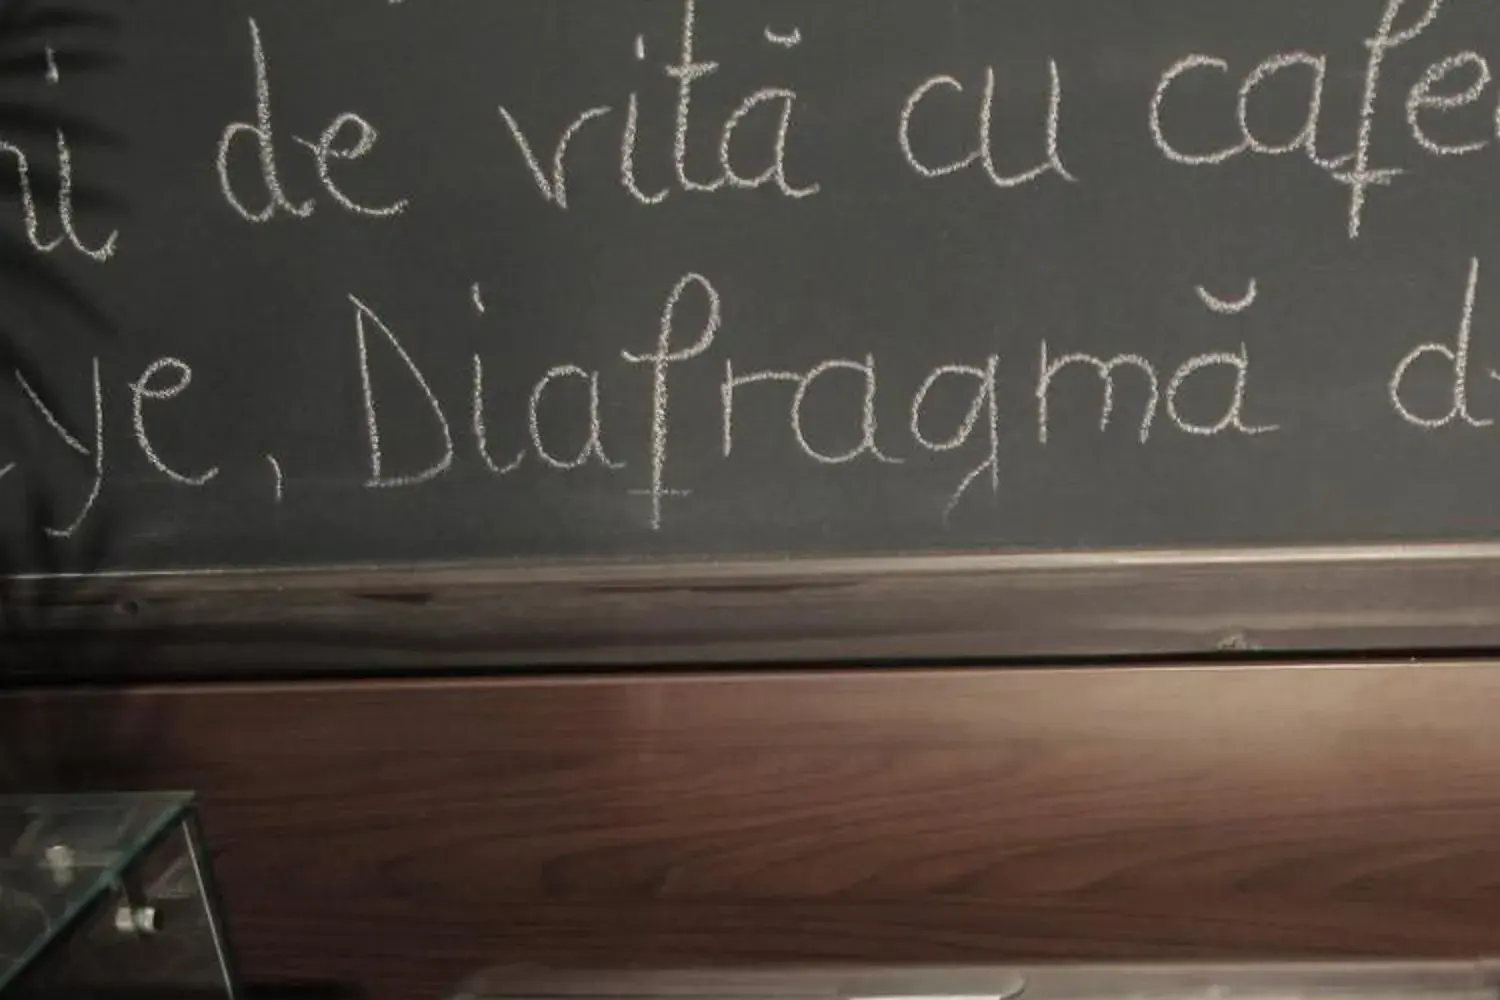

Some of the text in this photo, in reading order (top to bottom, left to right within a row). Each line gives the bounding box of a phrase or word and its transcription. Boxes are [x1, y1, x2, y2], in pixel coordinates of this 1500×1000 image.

[215, 17, 409, 223] de
[497, 0, 821, 208] vită
[898, 57, 1080, 187] cu
[347, 272, 1281, 530] Diafragmă
